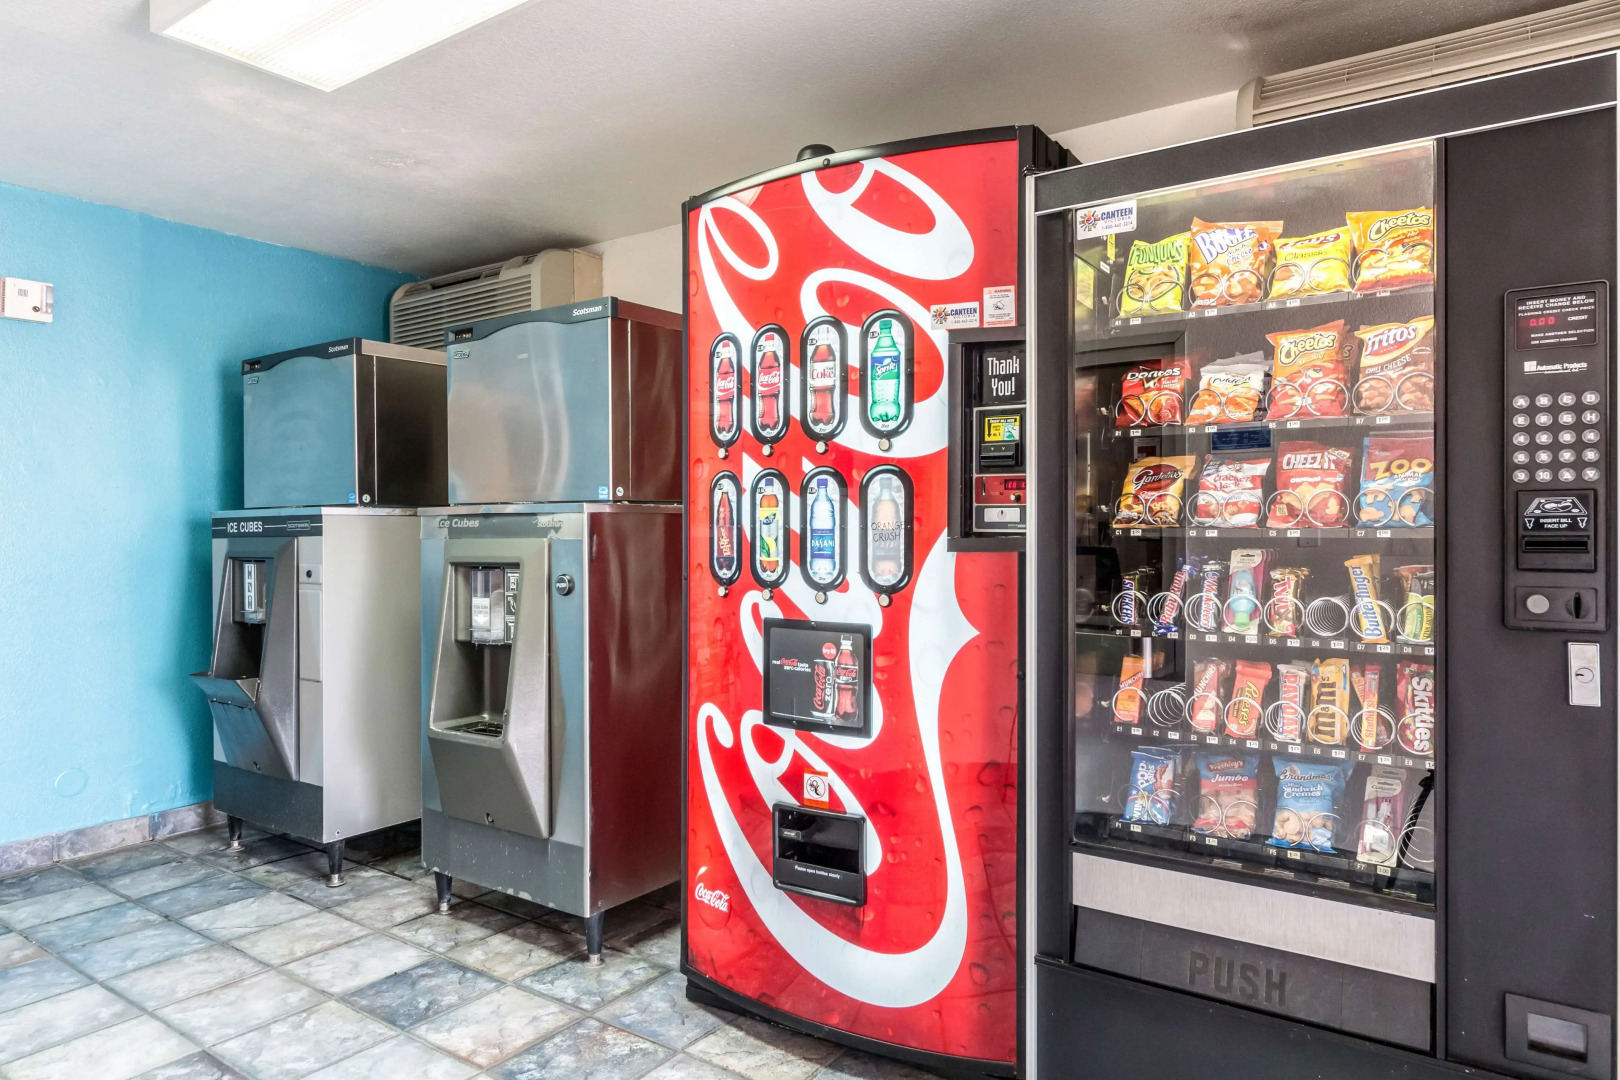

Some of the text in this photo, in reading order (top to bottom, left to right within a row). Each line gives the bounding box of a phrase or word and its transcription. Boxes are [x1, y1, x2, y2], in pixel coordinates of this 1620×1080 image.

[1100, 207, 1134, 221] CANTEEN
[1104, 216, 1132, 224] VICTORIA
[1368, 211, 1431, 242] Cheetos
[572, 305, 602, 317] Scotsman
[950, 307, 978, 317] CANTEEN
[1518, 303, 1544, 311] RECEIVE
[328, 344, 349, 353] Scotsman
[1279, 333, 1337, 366] Cheetos
[987, 355, 1020, 376] Thank
[1383, 353, 1412, 371] CHEESE
[811, 368, 834, 380] Coke
[875, 362, 898, 377] Sprite
[991, 376, 1016, 397] You!
[1369, 458, 1432, 481] ZOO
[227, 521, 263, 533] ICE CUBES
[438, 518, 480, 528] ce Cubes
[871, 521, 905, 531] ORANGE
[872, 532, 901, 542] CRUSH
[811, 538, 835, 549] DASANI
[1121, 578, 1135, 625] SNICKERS
[1411, 676, 1434, 752] Skittles
[1211, 773, 1249, 783] Jumbo
[1283, 783, 1324, 792] Sandwich
[1371, 784, 1398, 792] Colgate
[1283, 790, 1321, 799] Cremes
[695, 883, 730, 913] Coca-Cola
[1188, 950, 1287, 1007] PUSH
